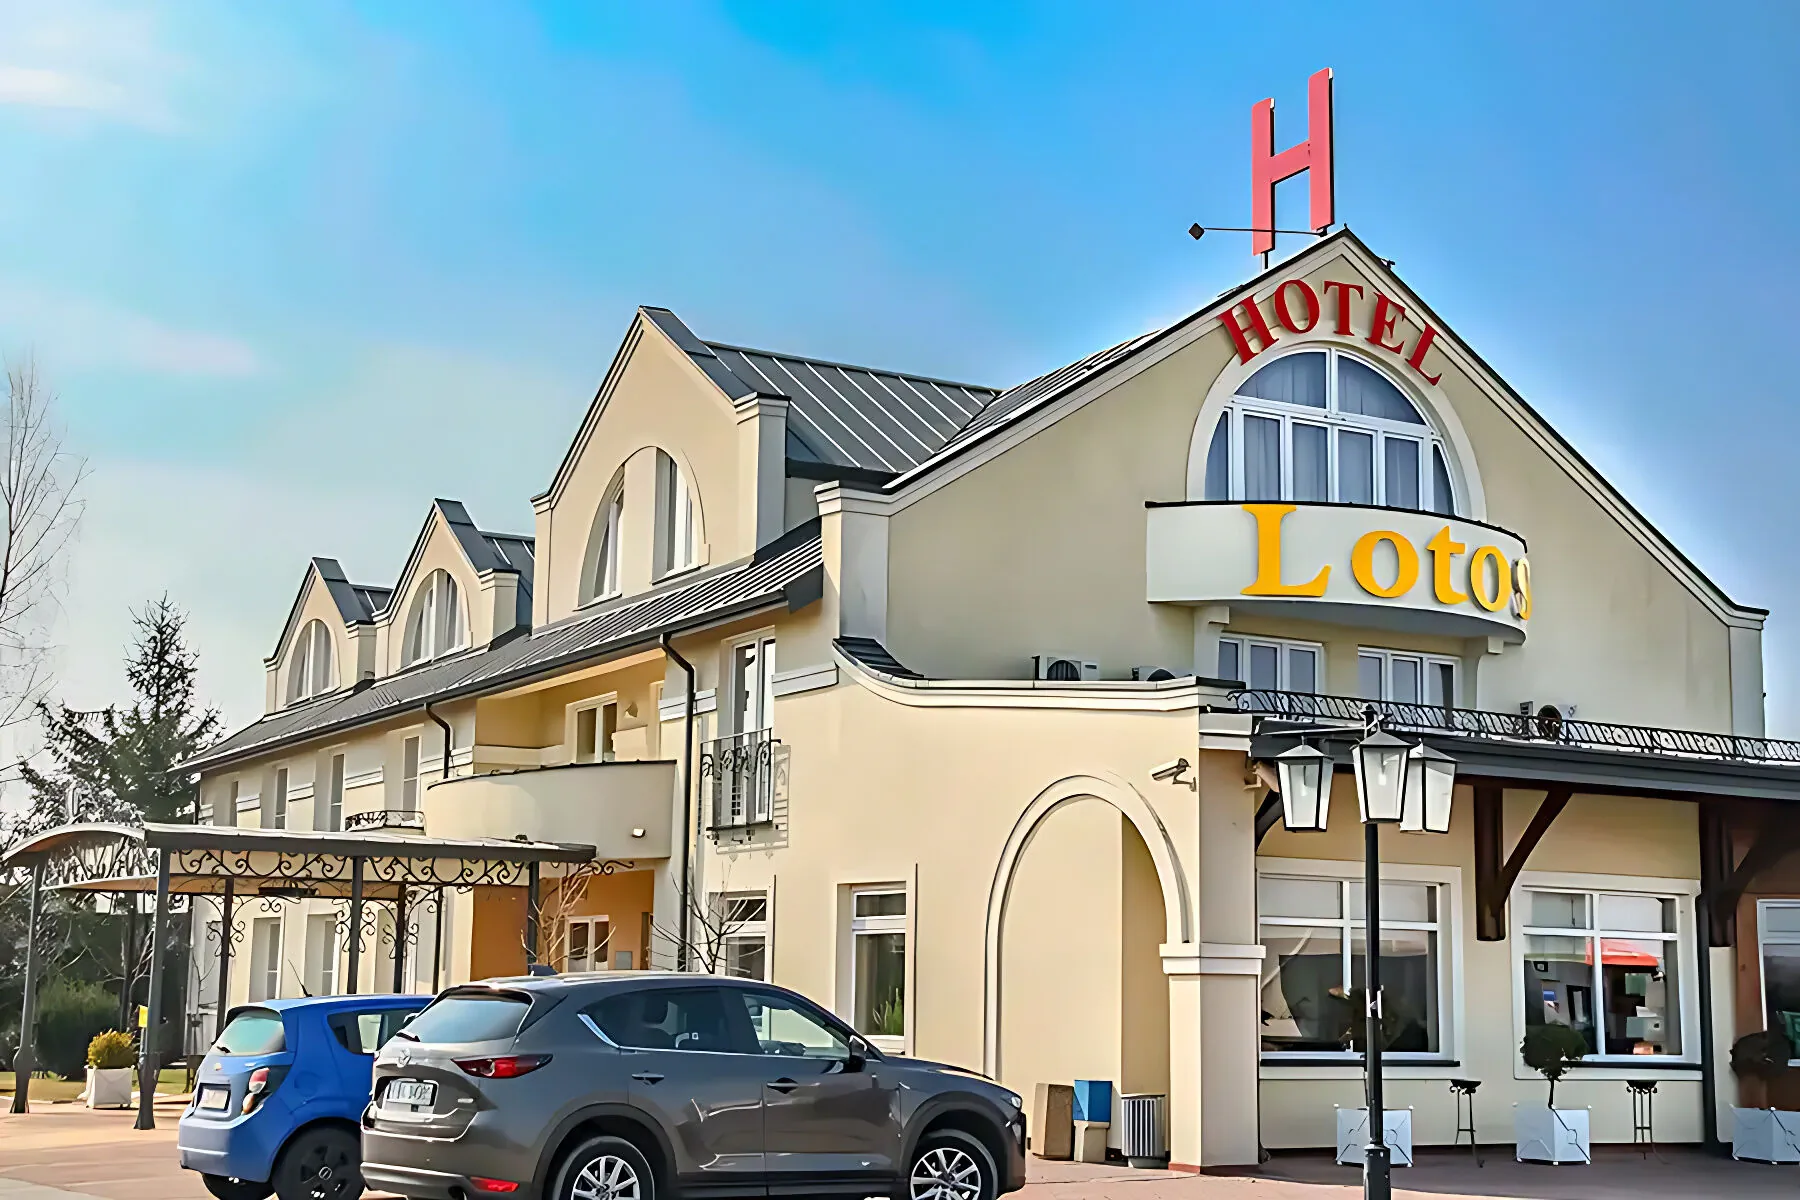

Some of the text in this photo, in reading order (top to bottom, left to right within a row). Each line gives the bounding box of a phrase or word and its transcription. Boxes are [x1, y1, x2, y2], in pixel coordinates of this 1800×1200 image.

[1252, 68, 1334, 256] H
[1217, 279, 1443, 386] HOTEL
[1240, 504, 1532, 620] Lotos
